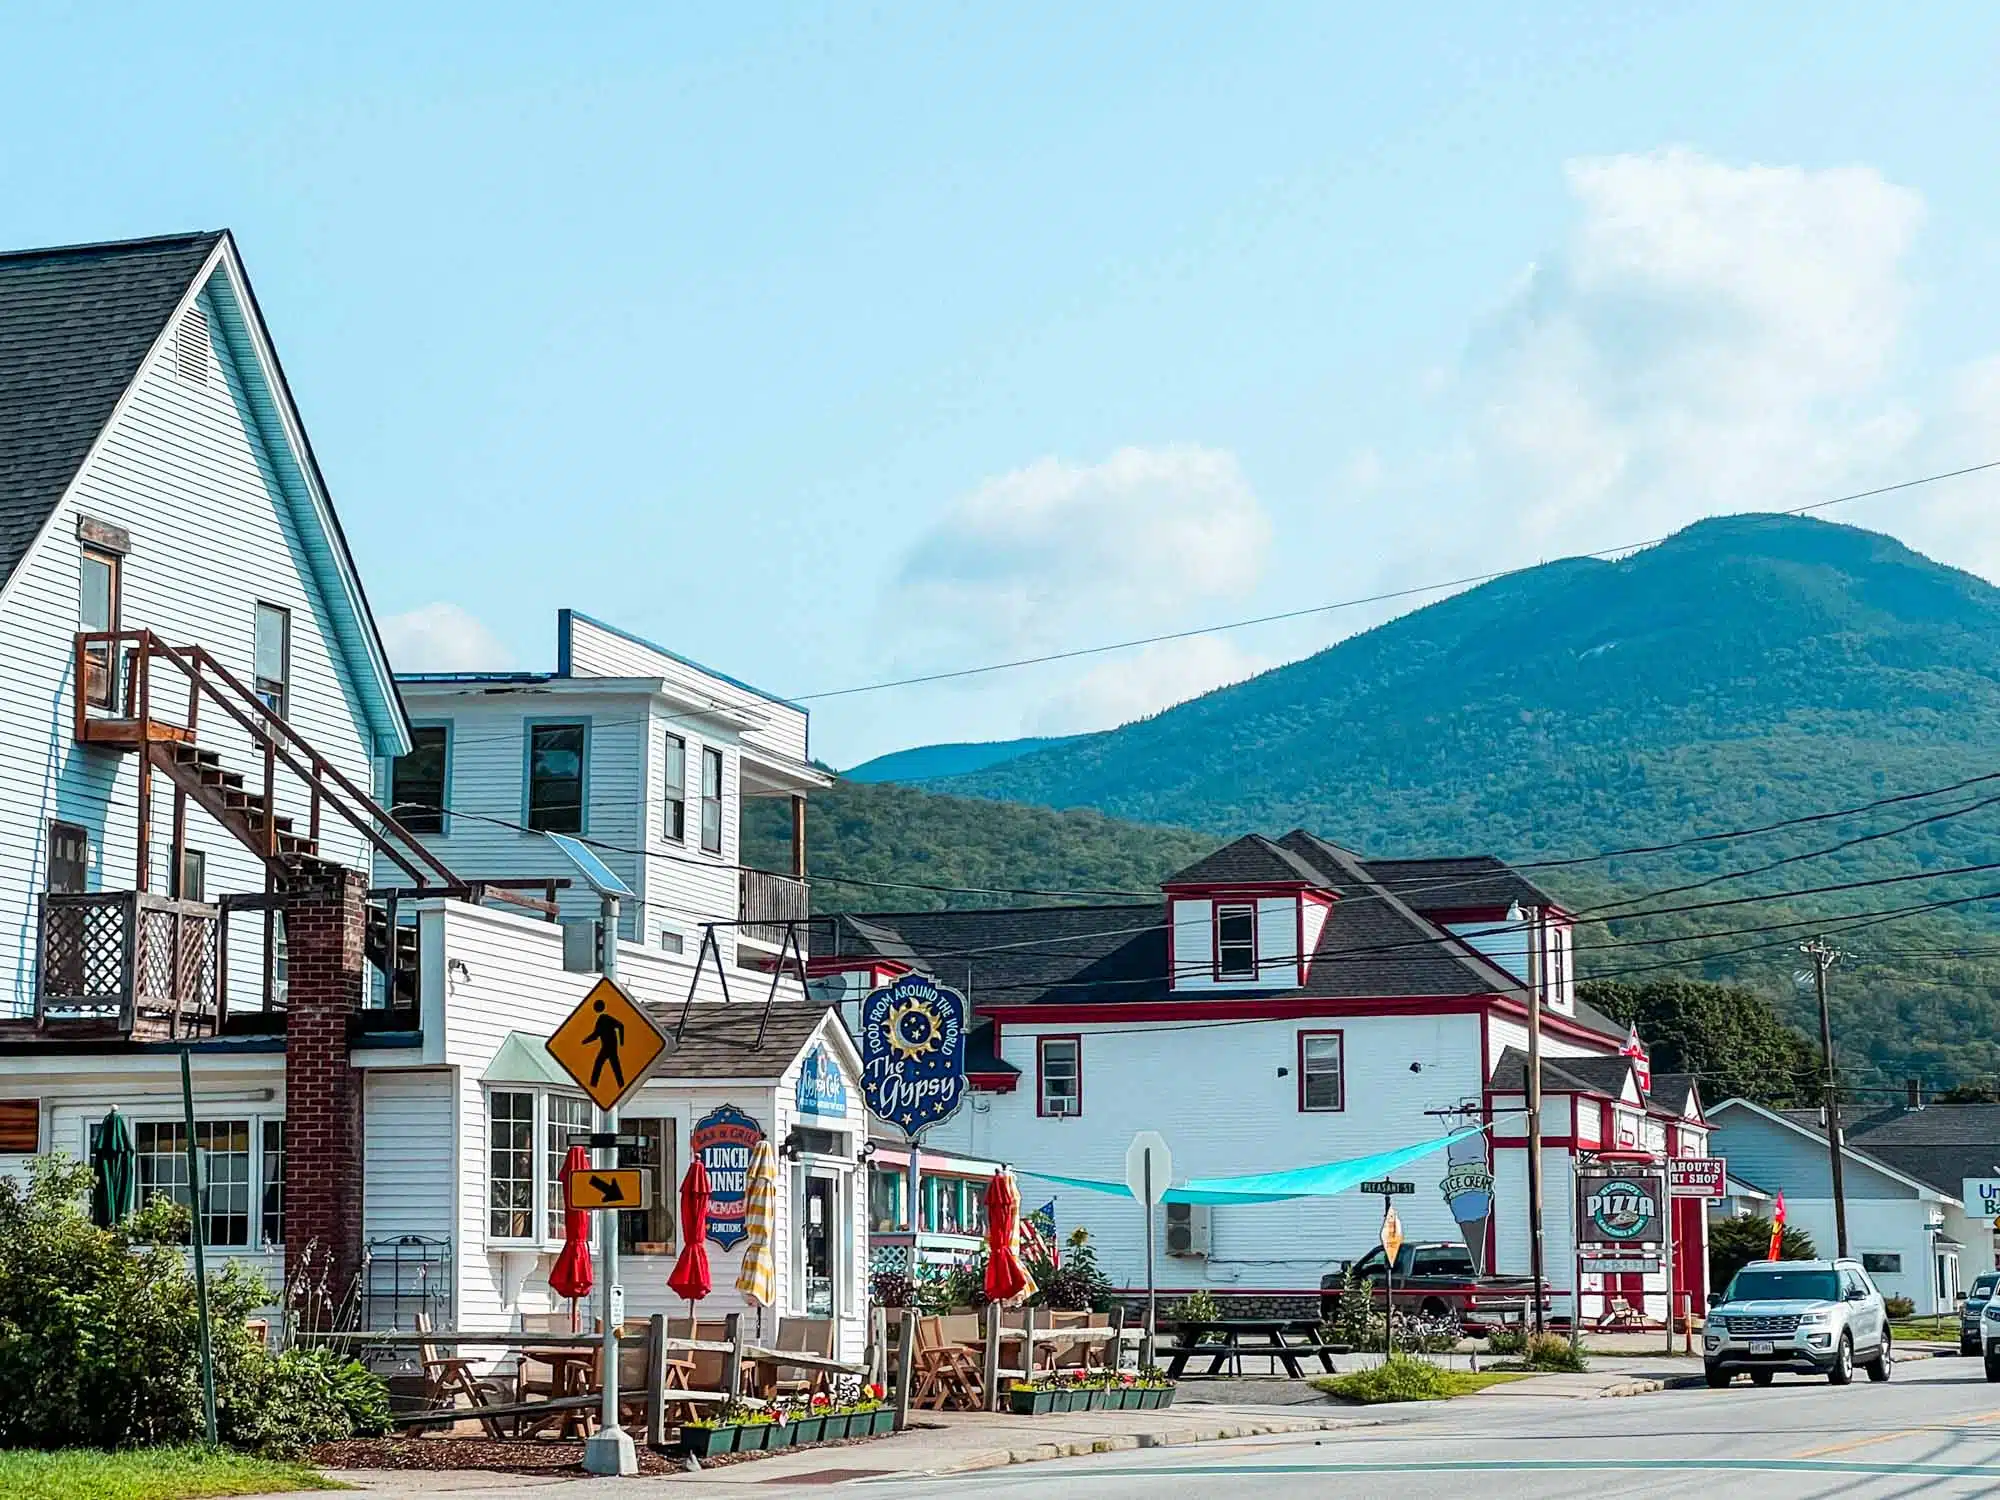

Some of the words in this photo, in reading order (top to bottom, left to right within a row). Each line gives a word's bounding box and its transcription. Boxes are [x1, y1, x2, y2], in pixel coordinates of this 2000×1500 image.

[894, 984, 938, 1002] AROUND
[869, 993, 895, 1022] FROM
[936, 997, 954, 1018] THE
[868, 1024, 884, 1055] FOOD
[941, 1017, 958, 1056] WORLD
[866, 1055, 905, 1079] The
[879, 1073, 955, 1119] Gypsy
[705, 1148, 749, 1169] LUNCH
[1670, 1161, 1721, 1174] AHOUT'S
[705, 1171, 748, 1192] INNE
[1364, 1183, 1400, 1193] PLEASANT
[1402, 1183, 1413, 1193] ST
[1445, 1178, 1462, 1191] ICE
[1463, 1175, 1494, 1191] CREAM
[1689, 1174, 1719, 1184] SHOP
[1586, 1195, 1655, 1217] PIZZA
